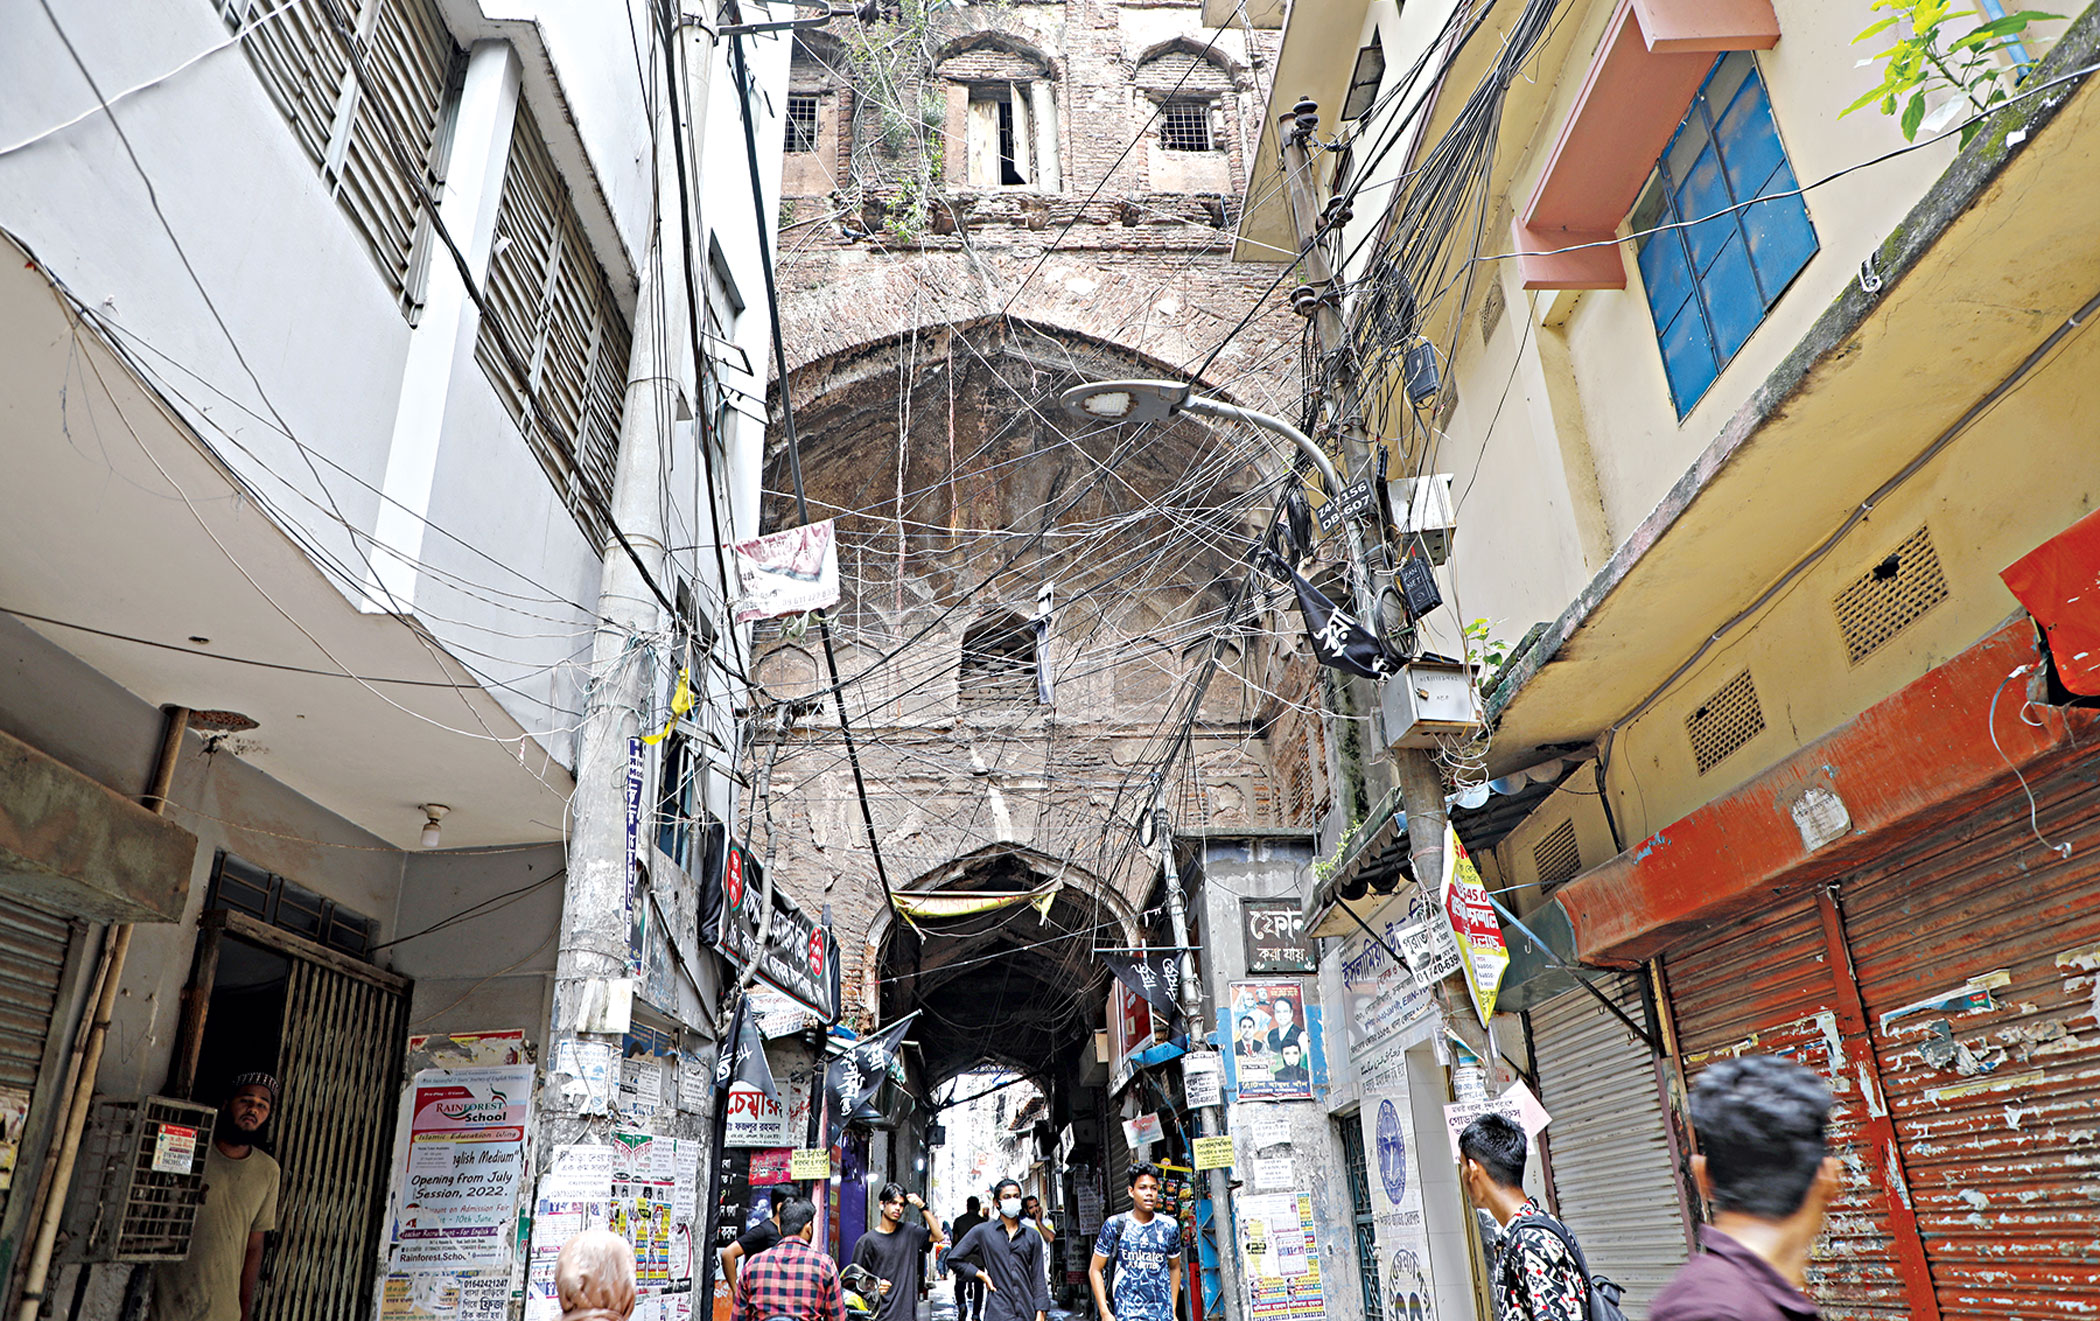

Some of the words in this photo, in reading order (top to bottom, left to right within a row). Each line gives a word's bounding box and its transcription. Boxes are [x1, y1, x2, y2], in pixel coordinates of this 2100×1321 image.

[1322, 494, 1370, 531] DB-607
[436, 1102, 504, 1113] RAINFOREST
[465, 1111, 507, 1122] School
[418, 1133, 446, 1141] Islamic
[450, 1131, 492, 1140] Education
[496, 1129, 517, 1139] Wing
[411, 1174, 454, 1187] Opening
[456, 1172, 485, 1181] from
[487, 1170, 513, 1184] July
[415, 1187, 463, 1200] Session,
[466, 1185, 509, 1198] 2022.
[1122, 1249, 1165, 1264] Emirates
